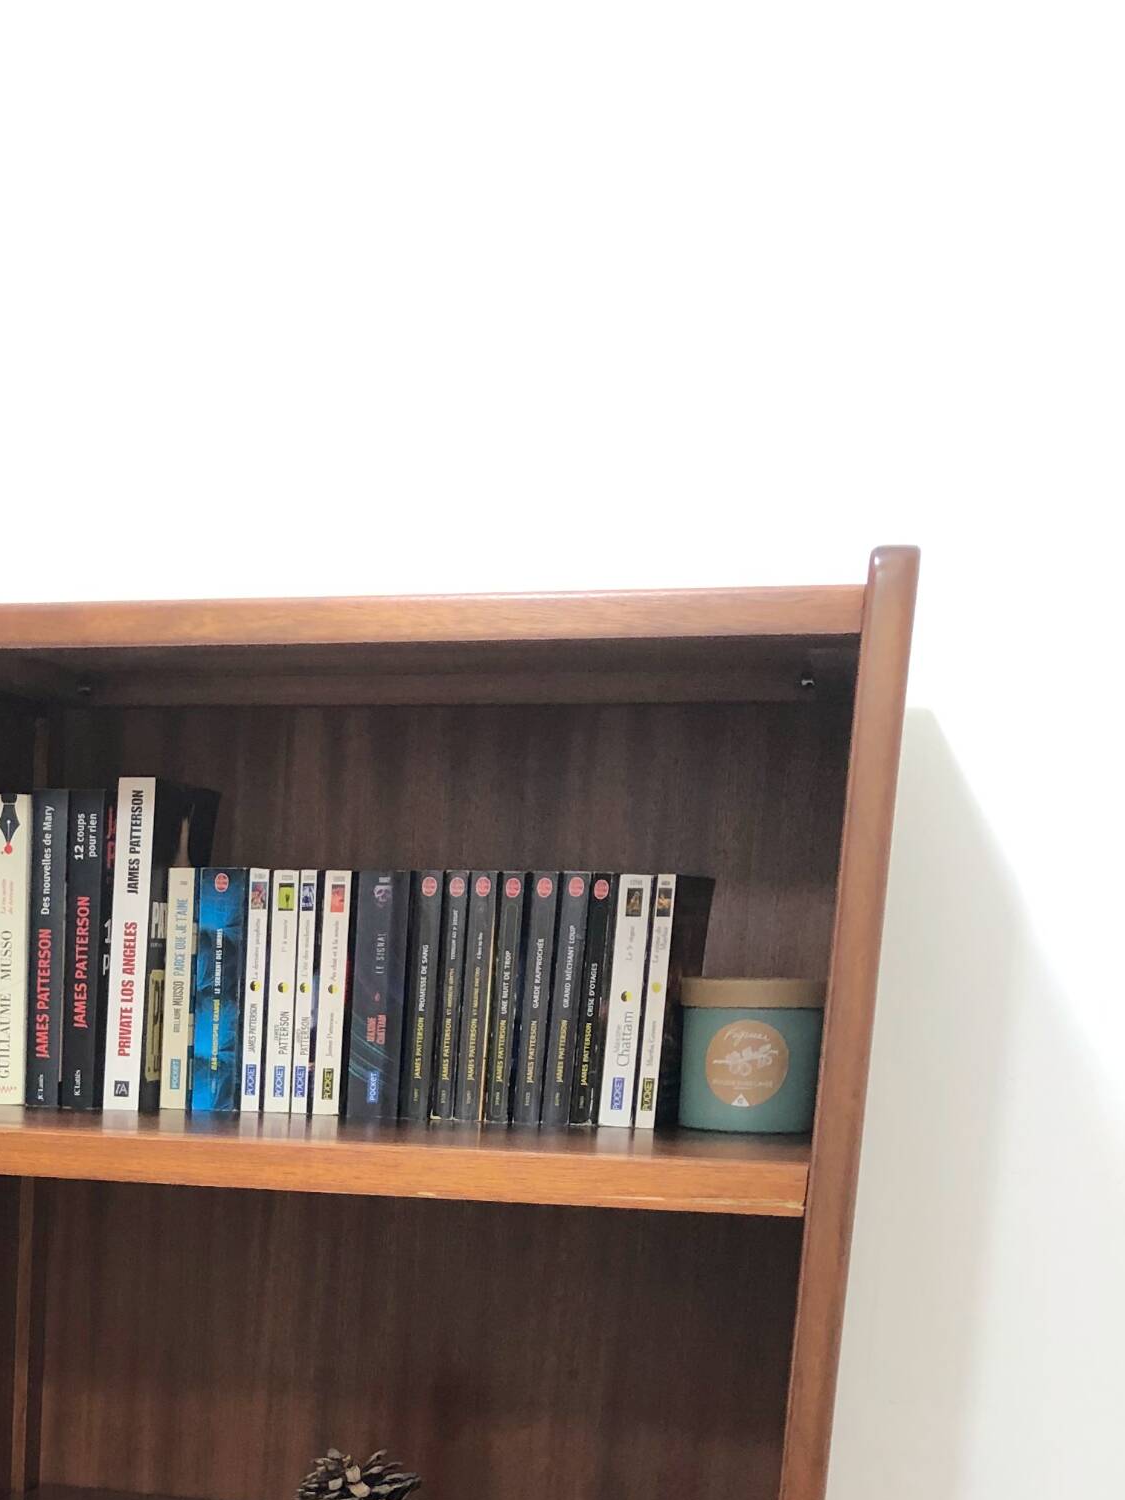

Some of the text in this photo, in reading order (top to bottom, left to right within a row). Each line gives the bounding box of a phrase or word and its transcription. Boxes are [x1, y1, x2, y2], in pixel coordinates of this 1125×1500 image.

[74, 813, 87, 860] 12 coups
[88, 813, 99, 857] pour rien
[126, 789, 144, 895] JAMES PATTERSON
[40, 805, 55, 915] Des nouvelles de Mary
[174, 898, 189, 921] T'AIME
[174, 924, 187, 934] JE
[174, 937, 187, 950] QUE
[568, 925, 576, 944] LOUP
[0, 930, 13, 981] MUSSO
[73, 896, 90, 1028] JAMES PATTERSON
[173, 953, 186, 976] PARCE
[375, 933, 386, 974] LE SIGNAL
[421, 944, 429, 964] SANG
[534, 938, 544, 984] RAPPROCHÉE
[564, 946, 575, 981] MÉCHANT
[214, 961, 222, 987] SERMENT
[420, 966, 428, 974] DE
[503, 971, 510, 980] DE
[588, 962, 598, 996] D'OTAGES
[35, 929, 52, 1058] JAMES PATTERSON
[117, 921, 137, 1057] PRIVATE LOS ANGELES
[172, 981, 185, 1006] MUSSO
[418, 976, 427, 1012] PROMESSE
[532, 985, 541, 1009] GARDE
[562, 983, 571, 1008] GRAND
[586, 998, 595, 1017] CRISE
[248, 1003, 257, 1053] JAMES PATTERSON
[278, 1011, 289, 1055] PATTERSON
[300, 1017, 310, 1055] PATTERSON
[415, 1017, 424, 1056] PATTERSON
[442, 1018, 452, 1057] PATTERSON
[468, 1018, 478, 1058] PATTERSON
[497, 1019, 506, 1059] PATTERSON
[527, 1020, 537, 1060] PATTERSON
[557, 1019, 568, 1060] PATTERSON
[582, 1022, 592, 1062] PATTERSON
[616, 1011, 634, 1067] Chattam
[171, 1059, 180, 1089] POCKET
[246, 1064, 256, 1095] POCKET
[274, 1066, 284, 1097] POCKET
[295, 1066, 306, 1097] POCKET
[323, 1068, 333, 1100] POCKET
[414, 1057, 422, 1079] JAMES
[441, 1058, 450, 1080] JAMES
[466, 1059, 475, 1080] JAMES
[495, 1061, 504, 1082] JAMES
[526, 1062, 535, 1083] JAMES
[555, 1061, 564, 1083] JAMES
[580, 1064, 589, 1086] JAMES
[612, 1078, 623, 1110] POCKET
[642, 1078, 653, 1111] POCKET
